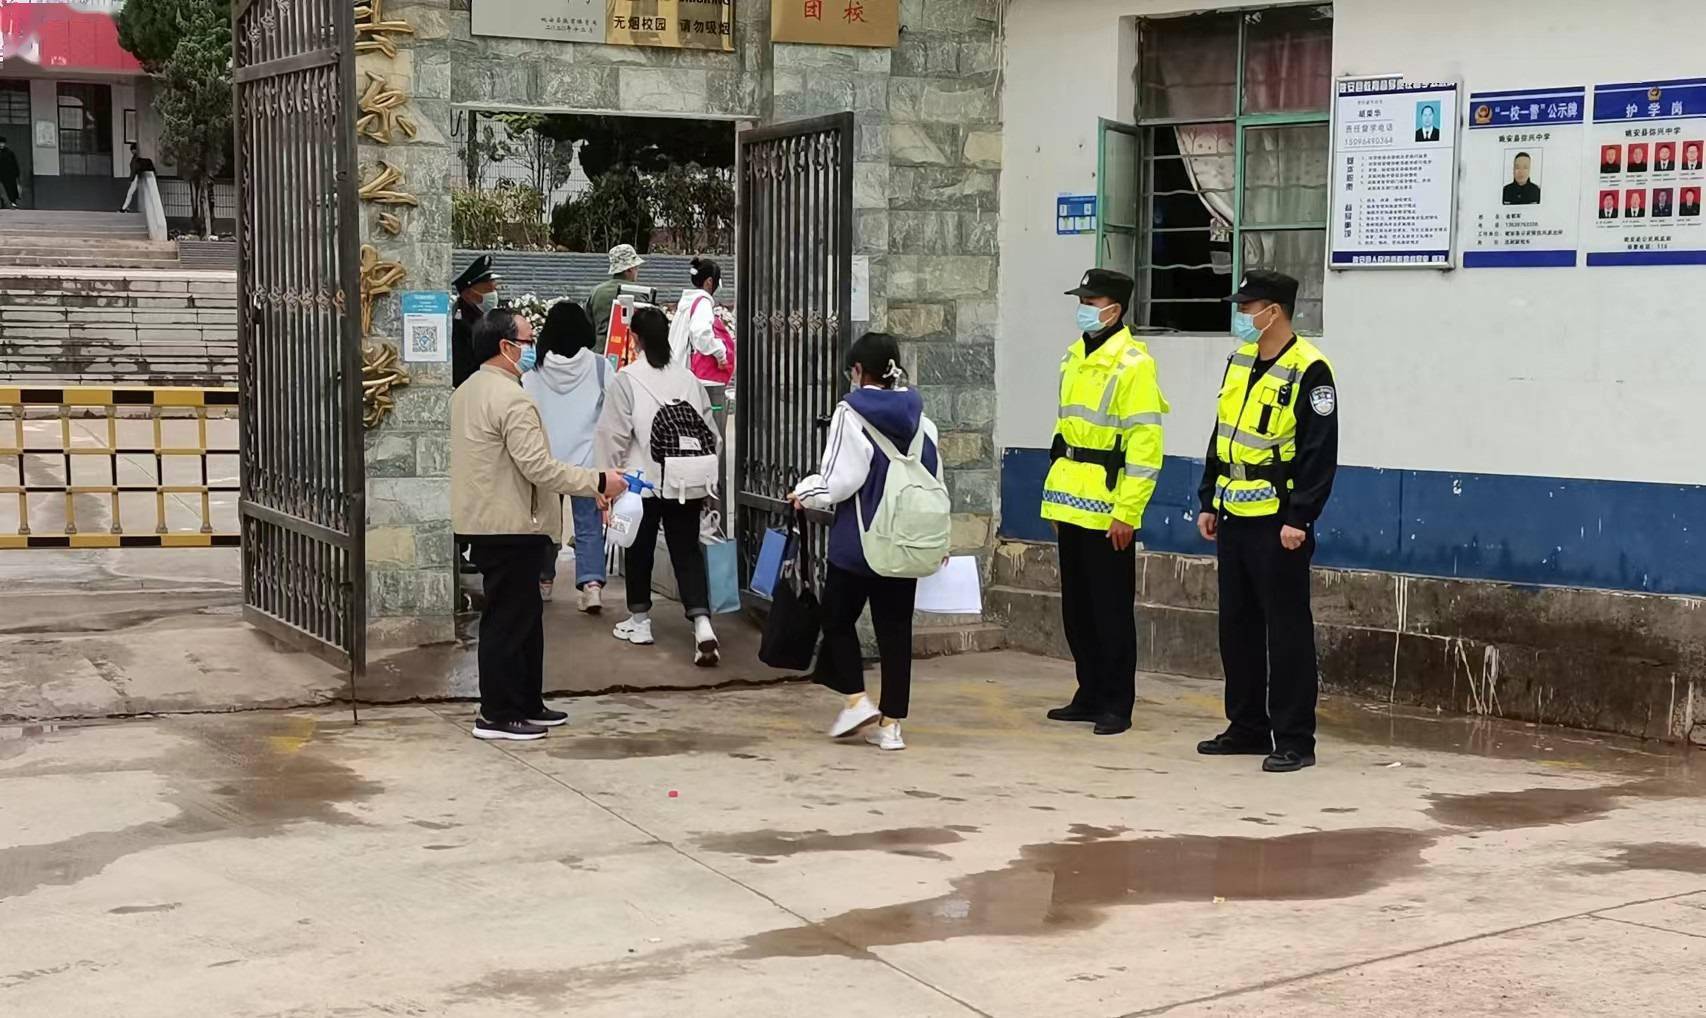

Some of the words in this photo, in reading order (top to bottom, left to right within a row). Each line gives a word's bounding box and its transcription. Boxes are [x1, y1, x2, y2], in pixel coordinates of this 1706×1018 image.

[614, 15, 667, 31] 无烟校园
[680, 19, 731, 36] 请勿吸烟
[1625, 100, 1683, 118] 护学岗
[1624, 126, 1682, 137] 姚安县弥兴中学
